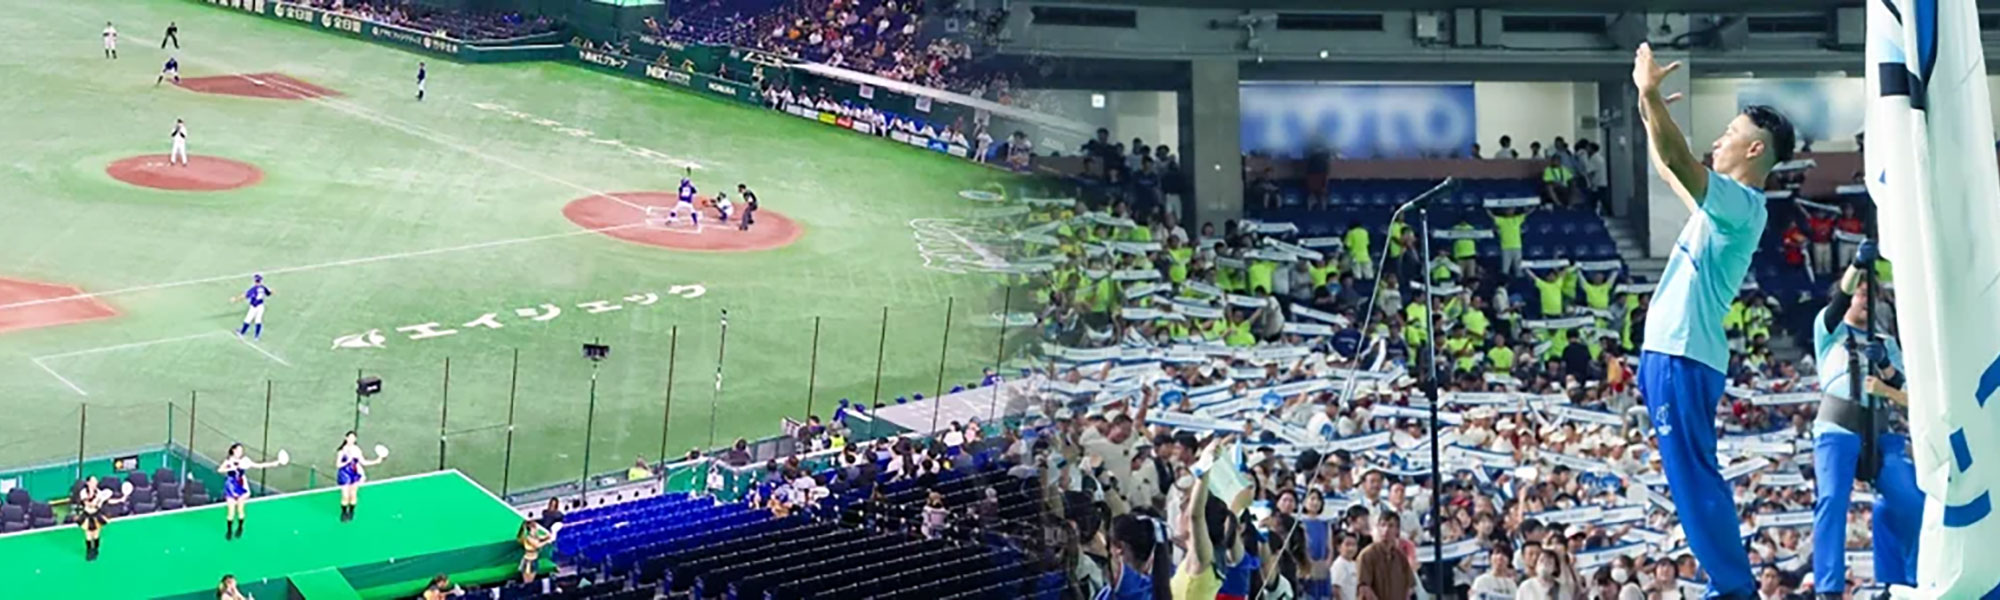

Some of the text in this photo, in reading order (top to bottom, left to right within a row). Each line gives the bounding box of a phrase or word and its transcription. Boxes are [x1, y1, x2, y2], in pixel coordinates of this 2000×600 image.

[396, 284, 706, 340] エイジェック
